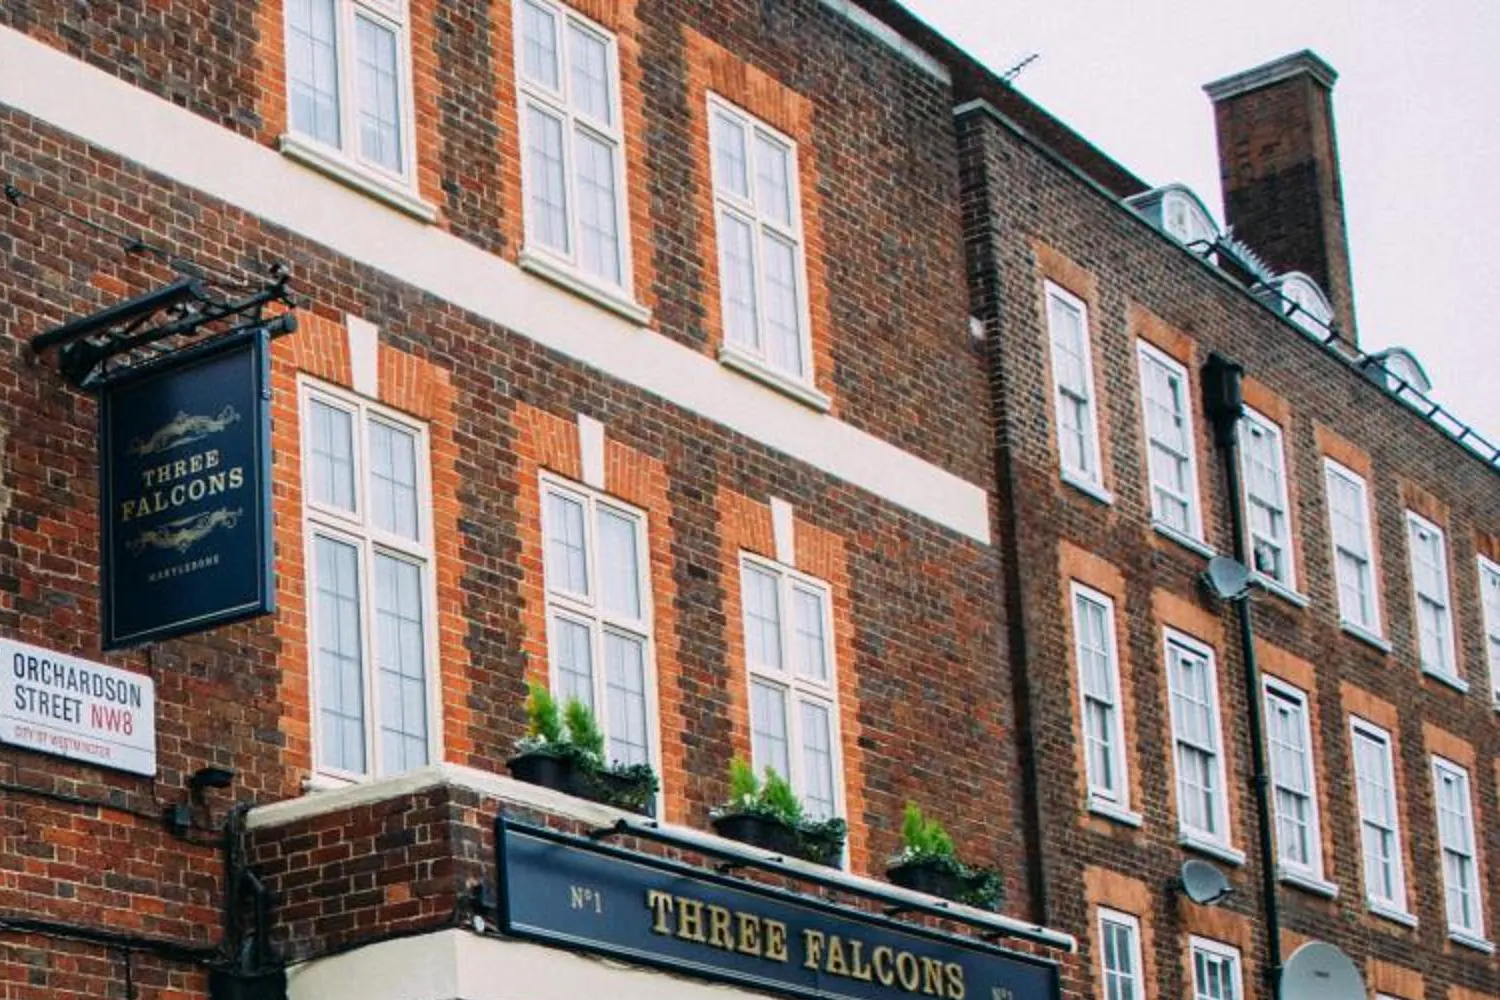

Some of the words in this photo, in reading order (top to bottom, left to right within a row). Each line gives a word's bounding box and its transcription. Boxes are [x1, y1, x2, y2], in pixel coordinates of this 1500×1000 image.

[121, 467, 244, 522] FALCONS
[142, 449, 220, 487] THREE
[13, 652, 142, 708] ORCHARDSON
[14, 684, 83, 724] STREET
[90, 703, 134, 736] NW8
[645, 888, 790, 964] THREE
[802, 927, 966, 1000] FALCONS
